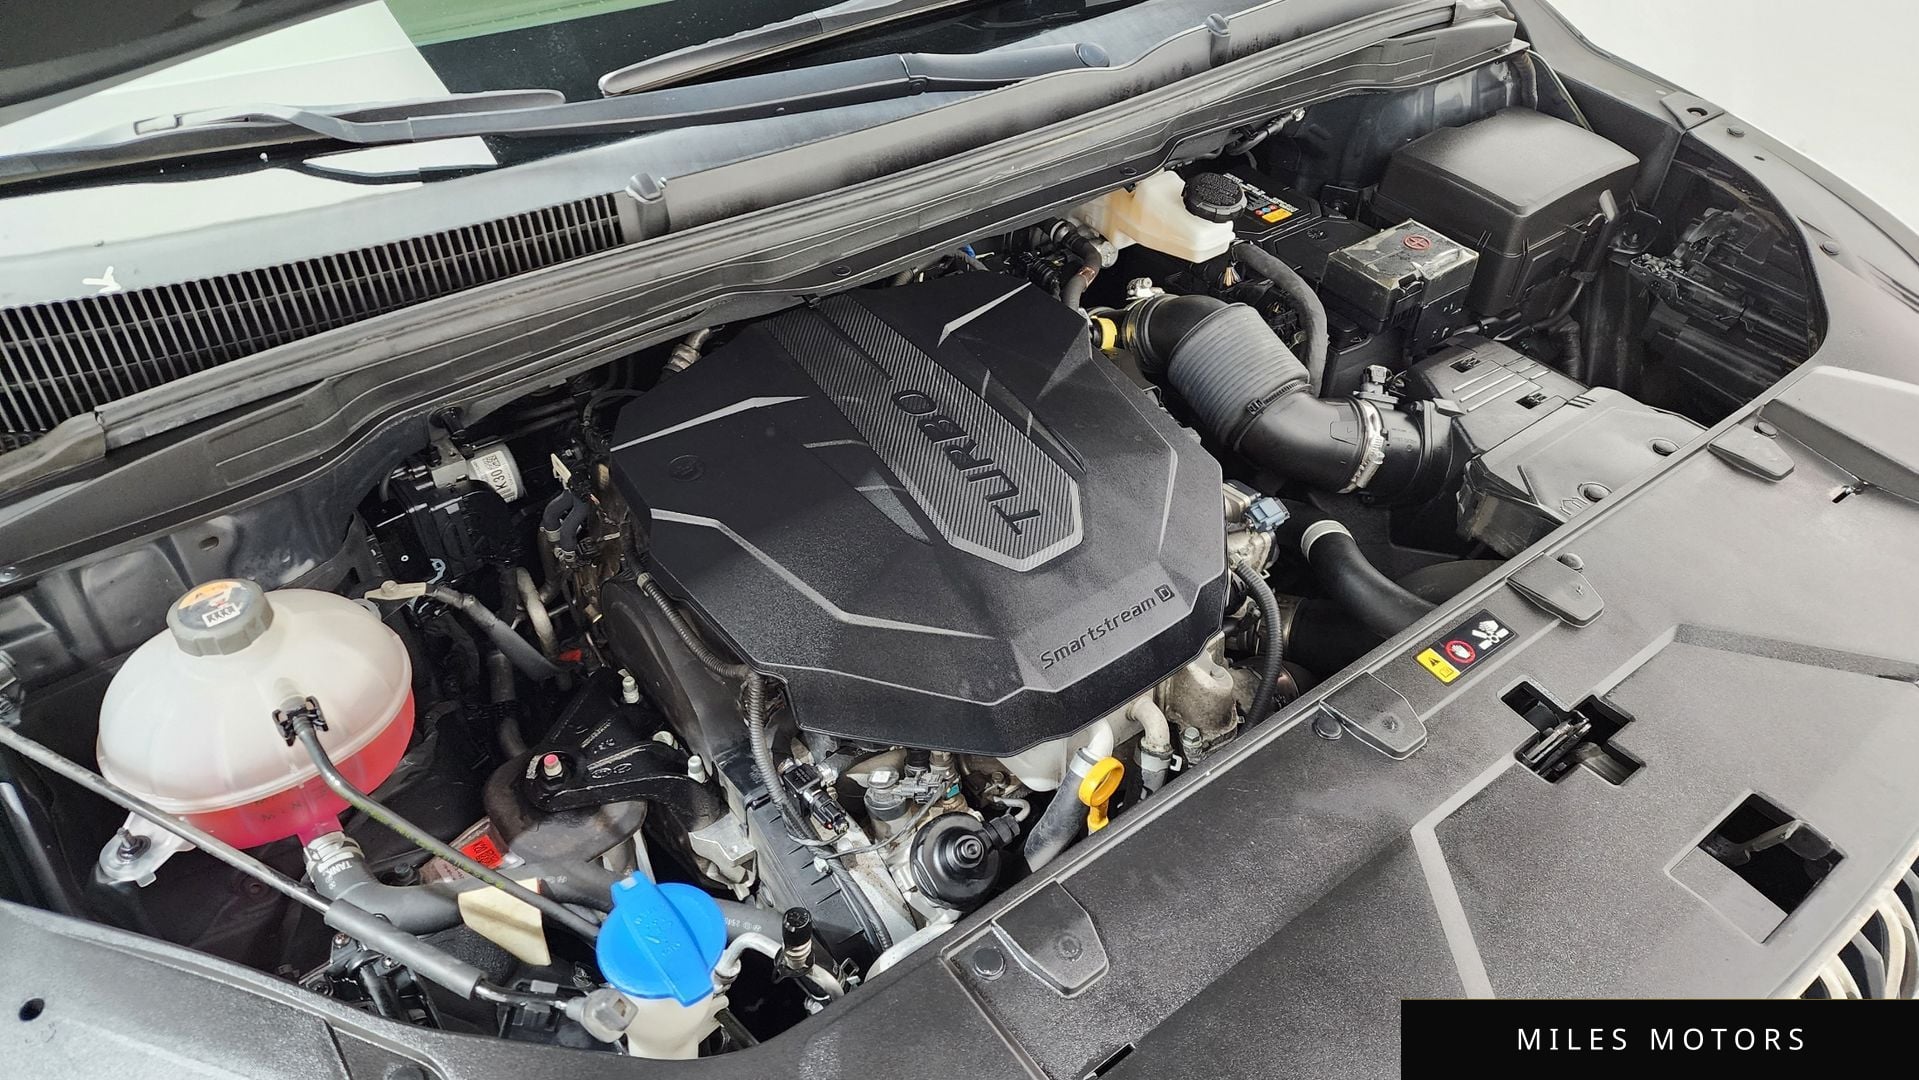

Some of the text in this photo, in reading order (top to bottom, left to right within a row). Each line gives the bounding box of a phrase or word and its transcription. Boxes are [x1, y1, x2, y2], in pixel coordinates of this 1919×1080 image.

[490, 469, 507, 490] K30
[892, 390, 1040, 535] TURBO
[1040, 597, 1156, 670] Smartstream
